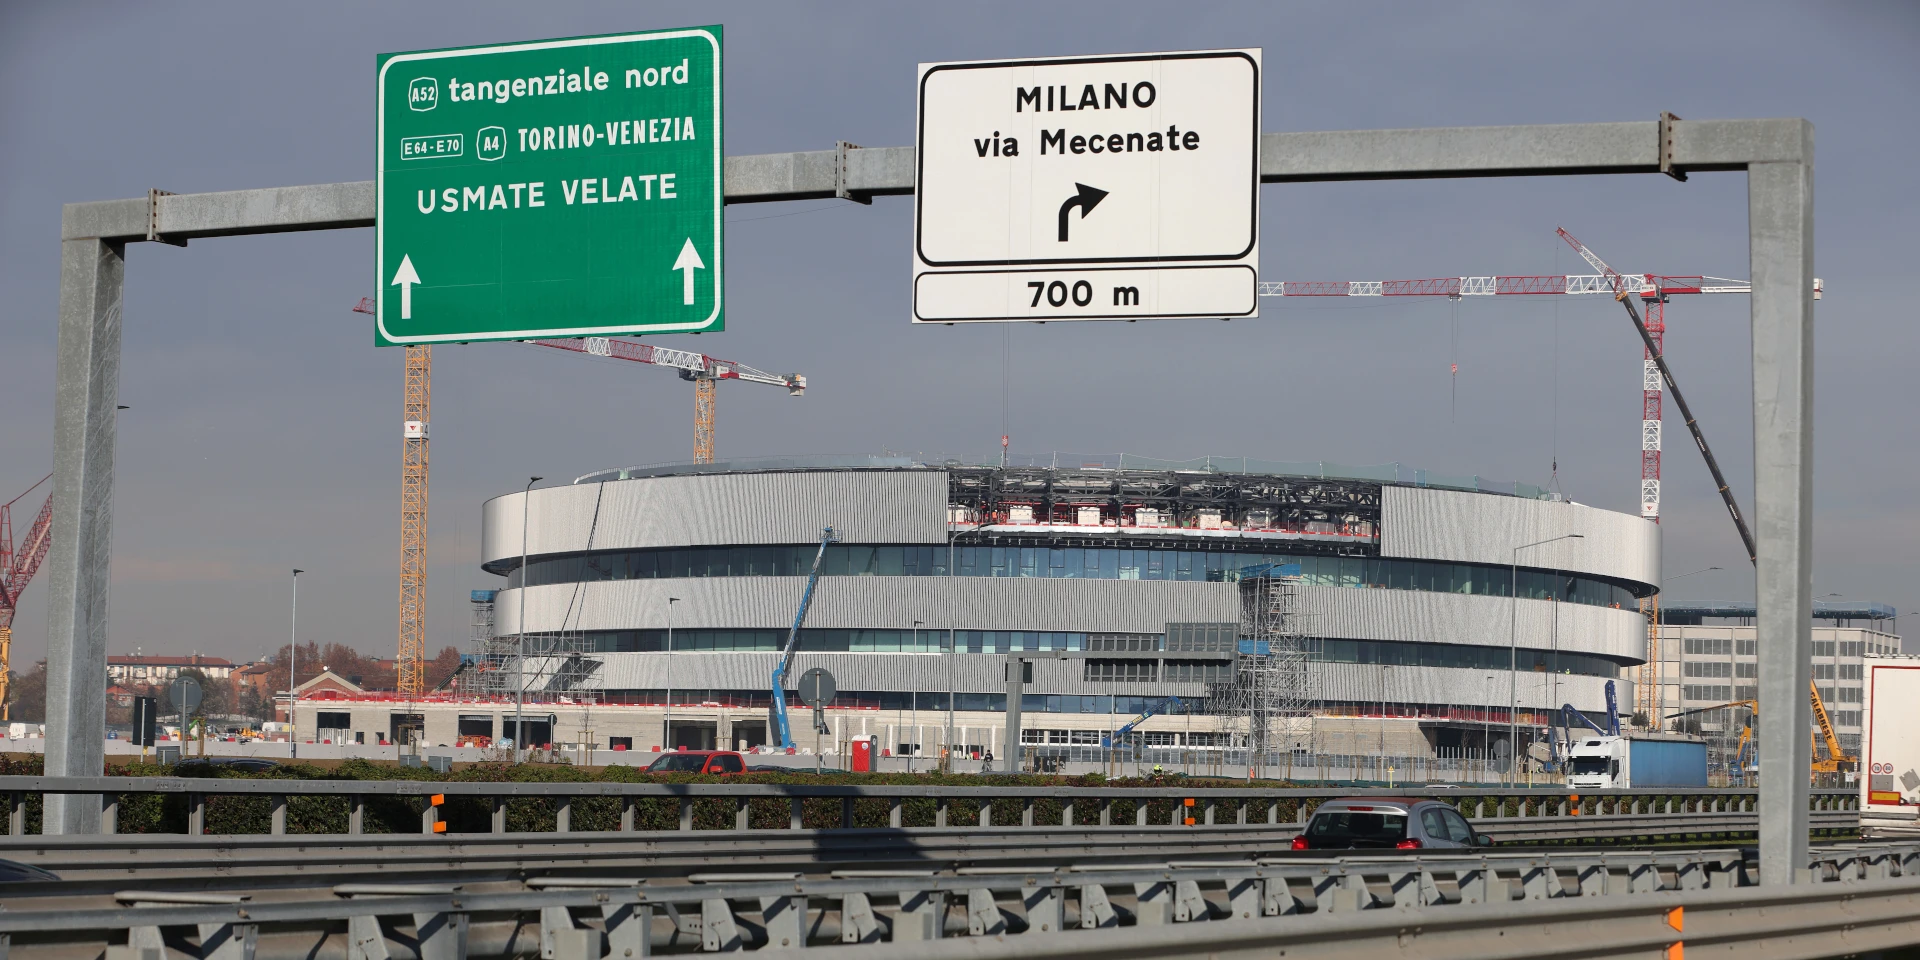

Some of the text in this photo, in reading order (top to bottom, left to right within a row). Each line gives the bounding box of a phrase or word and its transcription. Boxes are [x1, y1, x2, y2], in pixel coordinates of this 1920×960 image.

[411, 58, 689, 103] A52 tangenziale nord
[1016, 81, 1157, 113] MILANO
[483, 117, 696, 152] A4 TORINO-VENEZIA
[974, 125, 1200, 158] via Mecenate
[417, 173, 677, 214] USMATE VELATE
[1027, 280, 1140, 307] 700 m
[1811, 692, 1832, 740] CALABRESE
